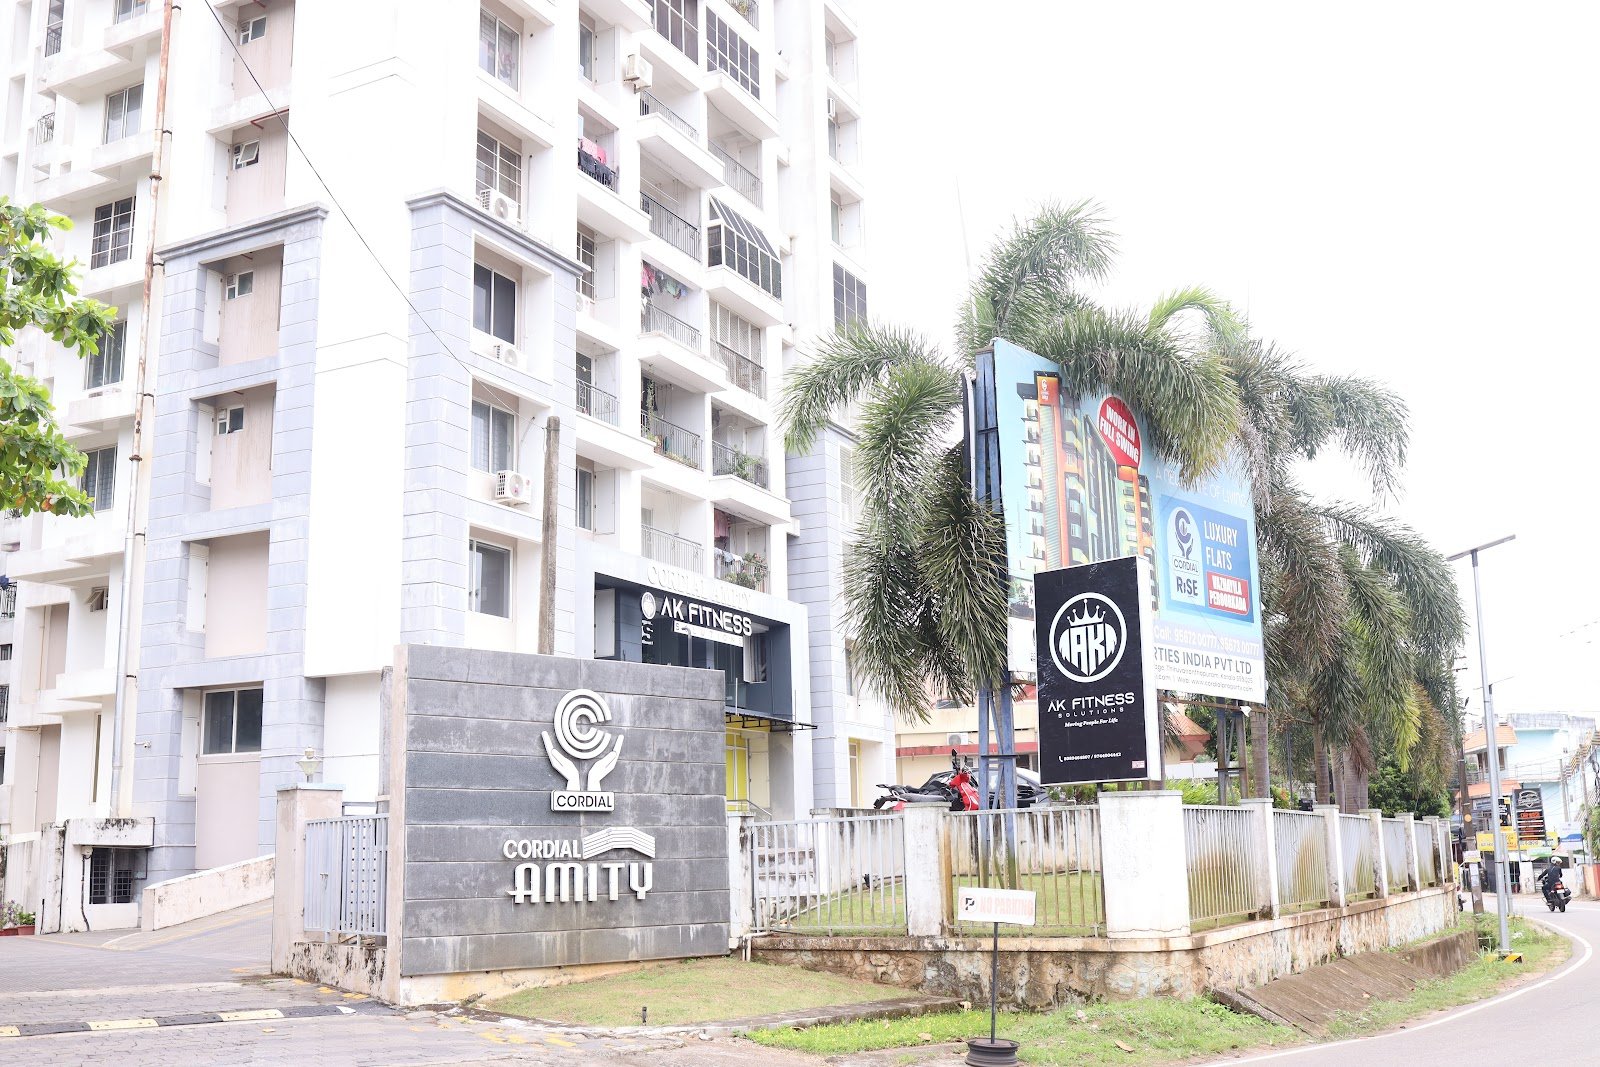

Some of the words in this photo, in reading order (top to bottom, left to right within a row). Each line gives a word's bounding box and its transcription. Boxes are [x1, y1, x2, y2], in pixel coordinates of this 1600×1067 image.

[1106, 404, 1127, 437] WORK
[1127, 424, 1136, 443] IN
[1100, 416, 1115, 442] FULL
[1116, 432, 1139, 464] SWING
[1204, 520, 1237, 547] LUXURY
[1173, 559, 1199, 573] CORDIAL
[1206, 547, 1232, 570] FLATS
[661, 596, 684, 620] AK
[688, 603, 752, 636] FITNESS
[1183, 651, 1211, 669] INDIA
[1214, 656, 1233, 672] PVT
[1235, 660, 1252, 674] LTD
[1047, 699, 1066, 712] AK
[1072, 692, 1135, 710] FITNESS
[1058, 707, 1124, 718] SOLUTIONS
[557, 795, 612, 807] CORDIAL
[503, 839, 581, 859] CORDIAL
[506, 862, 653, 904] AMITY
[980, 896, 992, 913] NO
[995, 897, 1033, 917] PARKING
